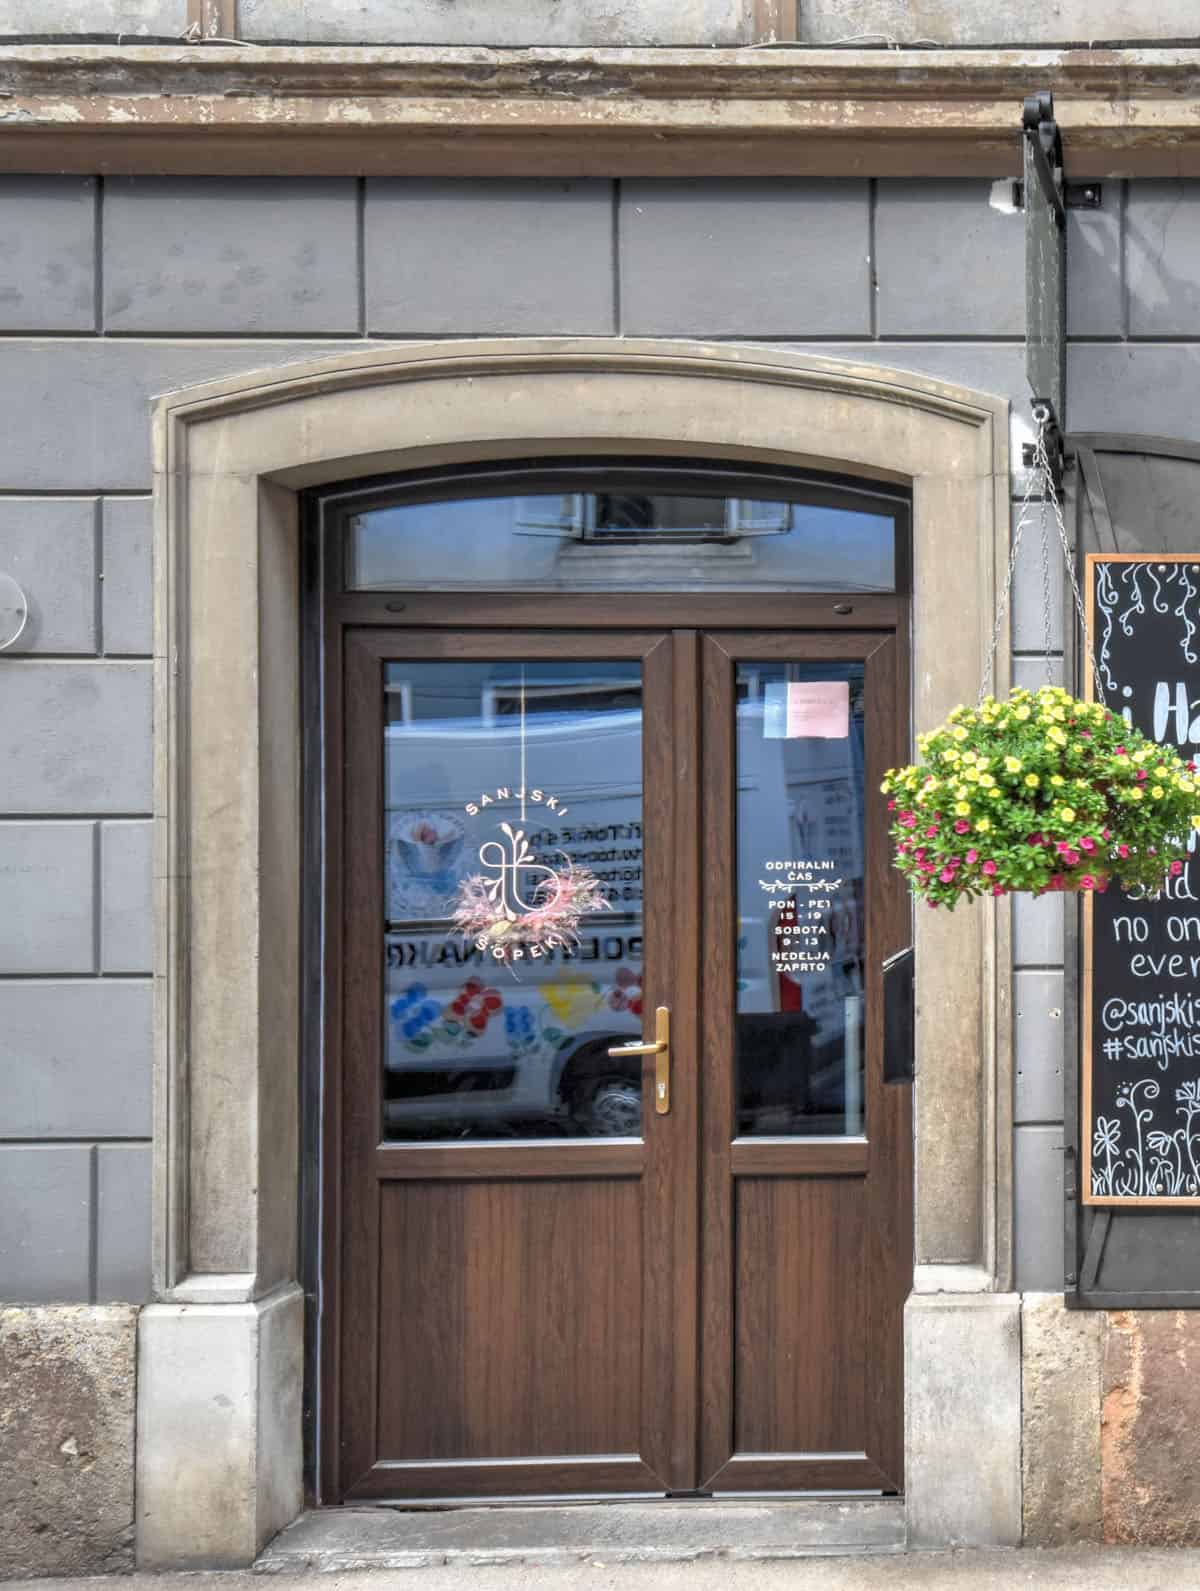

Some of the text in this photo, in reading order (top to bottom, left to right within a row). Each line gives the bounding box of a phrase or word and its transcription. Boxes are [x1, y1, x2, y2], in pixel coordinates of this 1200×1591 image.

[464, 787, 569, 817] SANJSKI
[765, 861, 835, 870] ODPIRALNI
[787, 871, 813, 881] ČAS
[768, 900, 795, 909] PON
[808, 900, 832, 909] PET
[780, 912, 794, 920] 15
[775, 926, 826, 935] SOBOTA
[1113, 917, 1149, 942] no
[805, 938, 819, 946] 13
[772, 952, 830, 961] NEDELJA
[776, 963, 825, 972] ZAPRTO
